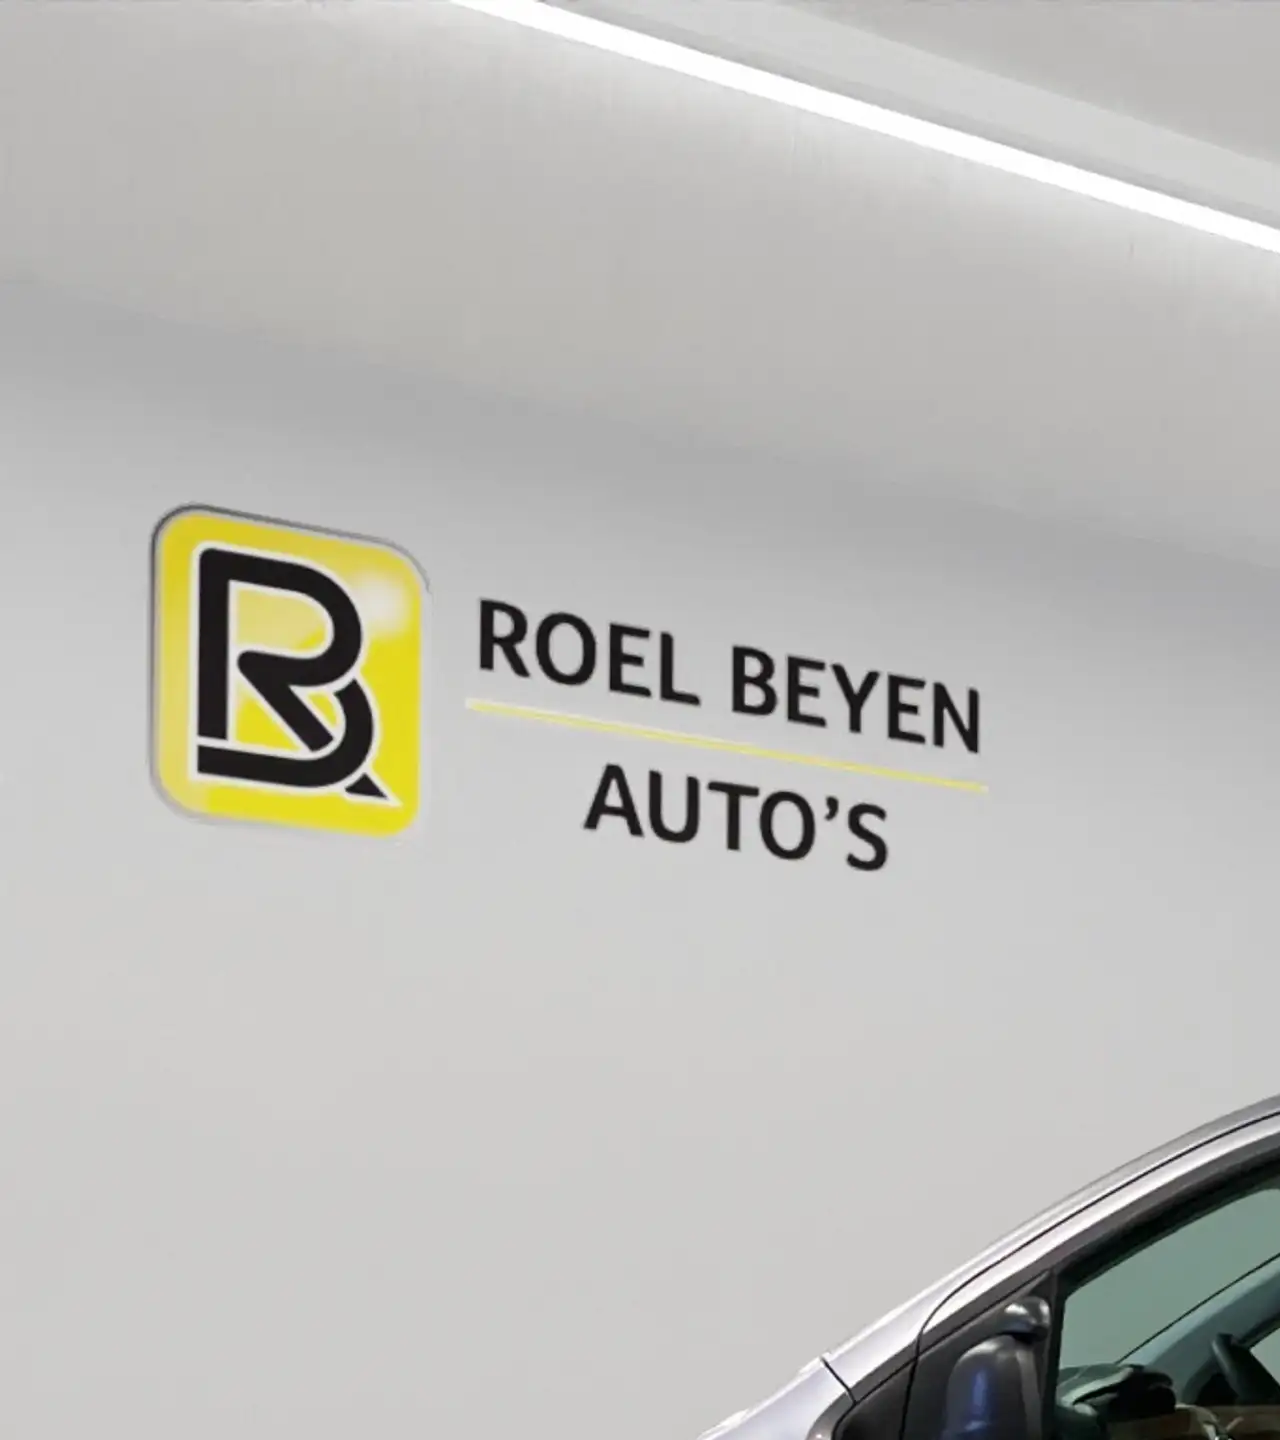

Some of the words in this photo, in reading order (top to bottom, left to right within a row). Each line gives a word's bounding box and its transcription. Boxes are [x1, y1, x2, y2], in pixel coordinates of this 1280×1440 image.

[479, 599, 701, 706] ROEL
[732, 645, 980, 754] BEYEN
[583, 764, 888, 872] AUTO'S
